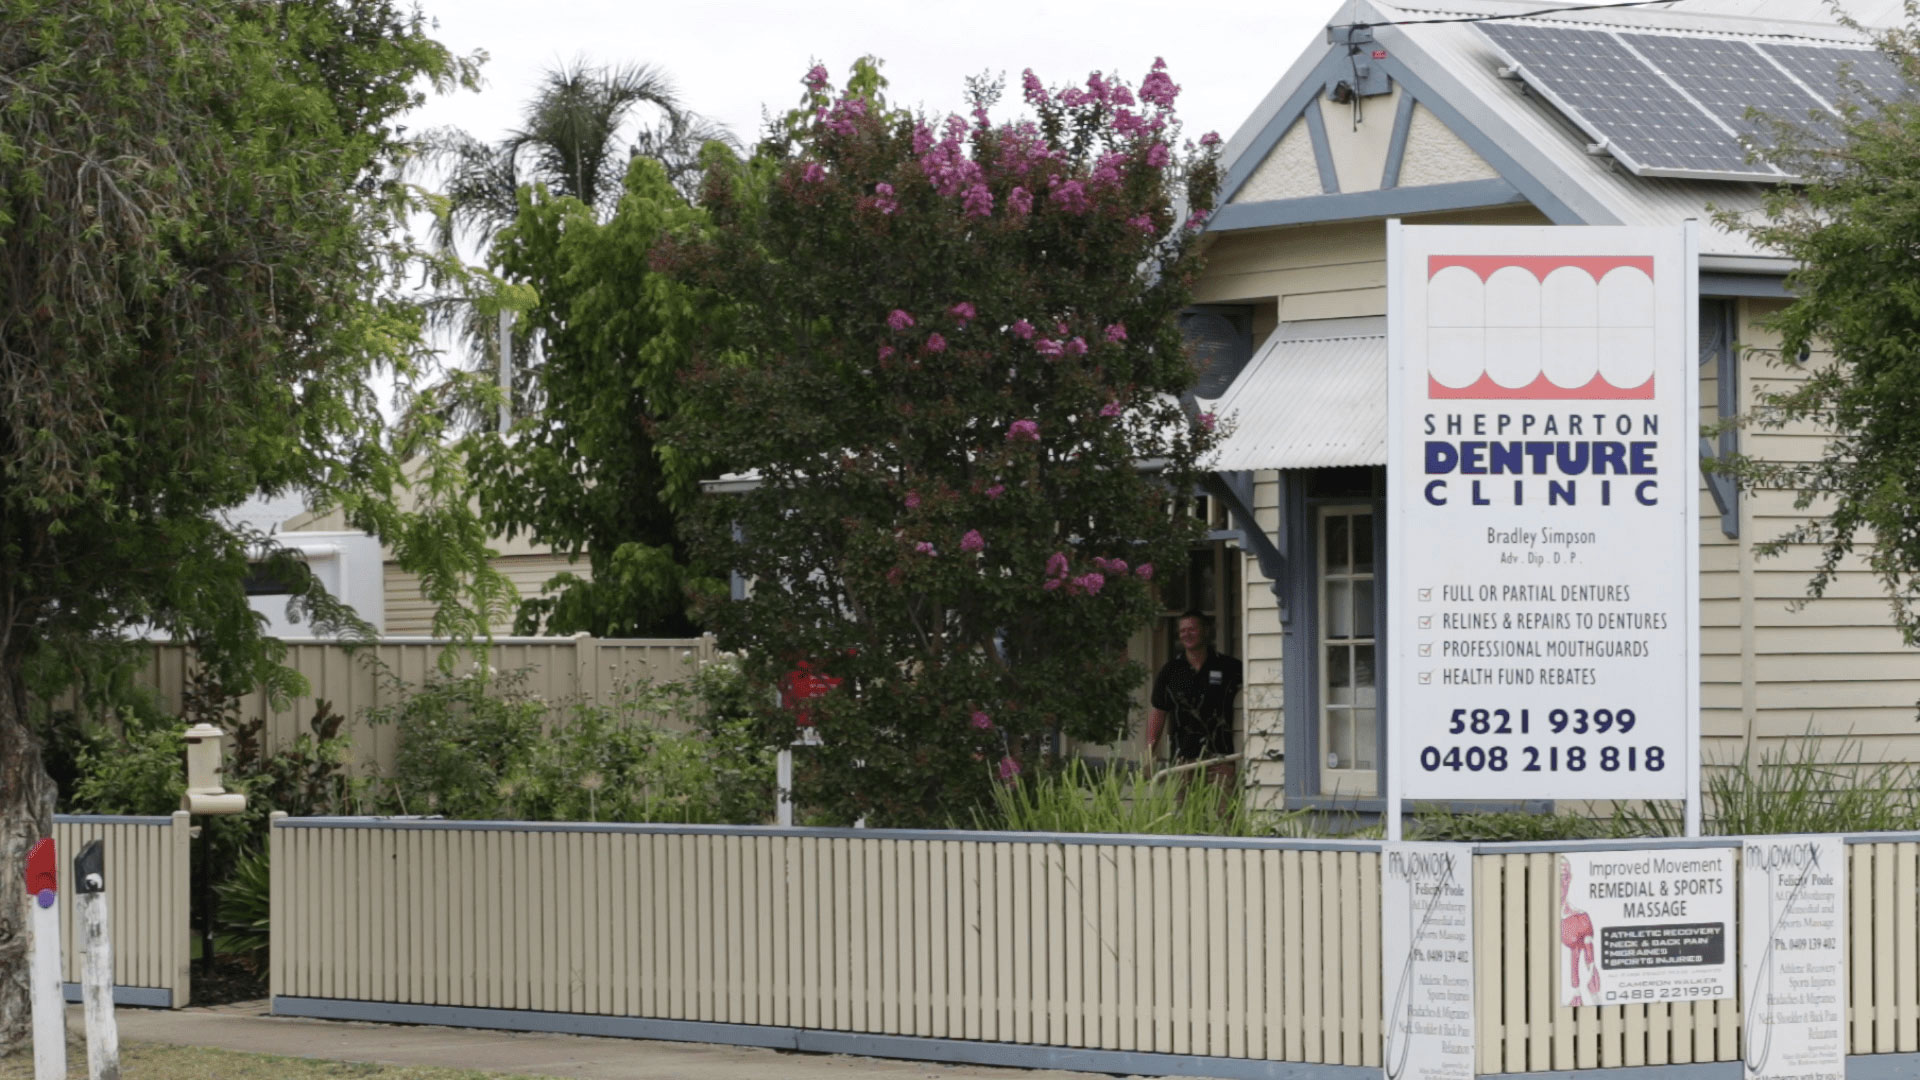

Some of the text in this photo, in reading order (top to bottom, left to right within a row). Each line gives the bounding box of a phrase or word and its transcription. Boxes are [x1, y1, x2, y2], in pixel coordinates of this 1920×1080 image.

[1424, 414, 1658, 435] SHEPPARTON
[1424, 441, 1658, 474] DENTURE
[1424, 480, 1658, 506] CLINIC
[1487, 527, 1595, 547] Bradley Simpson
[1443, 585, 1630, 601] FULL OR PARTIAL DENTURES
[1443, 613, 1667, 629] RELINES & REPAIRS TO DENTURES
[1443, 641, 1649, 657] PROFESSIONAL MOUTHGUARDS
[1443, 668, 1596, 684] HEALTH FUND REBATES
[1449, 709, 1636, 734] 5821 9399
[1420, 746, 1664, 771] 0408 218 818
[1590, 858, 1722, 879] Improved Movement
[1812, 874, 1834, 886] Poole
[1590, 879, 1723, 898] REMEDIAL & SPORTS
[1623, 901, 1687, 918] MASSAGE
[1610, 928, 1720, 938] ATHLETIC RECOVERY
[1610, 939, 1638, 947] NECK
[1652, 938, 1681, 946] BACK
[1684, 937, 1708, 945] PAIN
[1775, 939, 1787, 951] Ph.
[1808, 938, 1822, 949] 139
[1610, 948, 1667, 956] MIGRAINES
[1610, 957, 1653, 966] SPORTS
[1606, 986, 1723, 1000] 0488 221990
